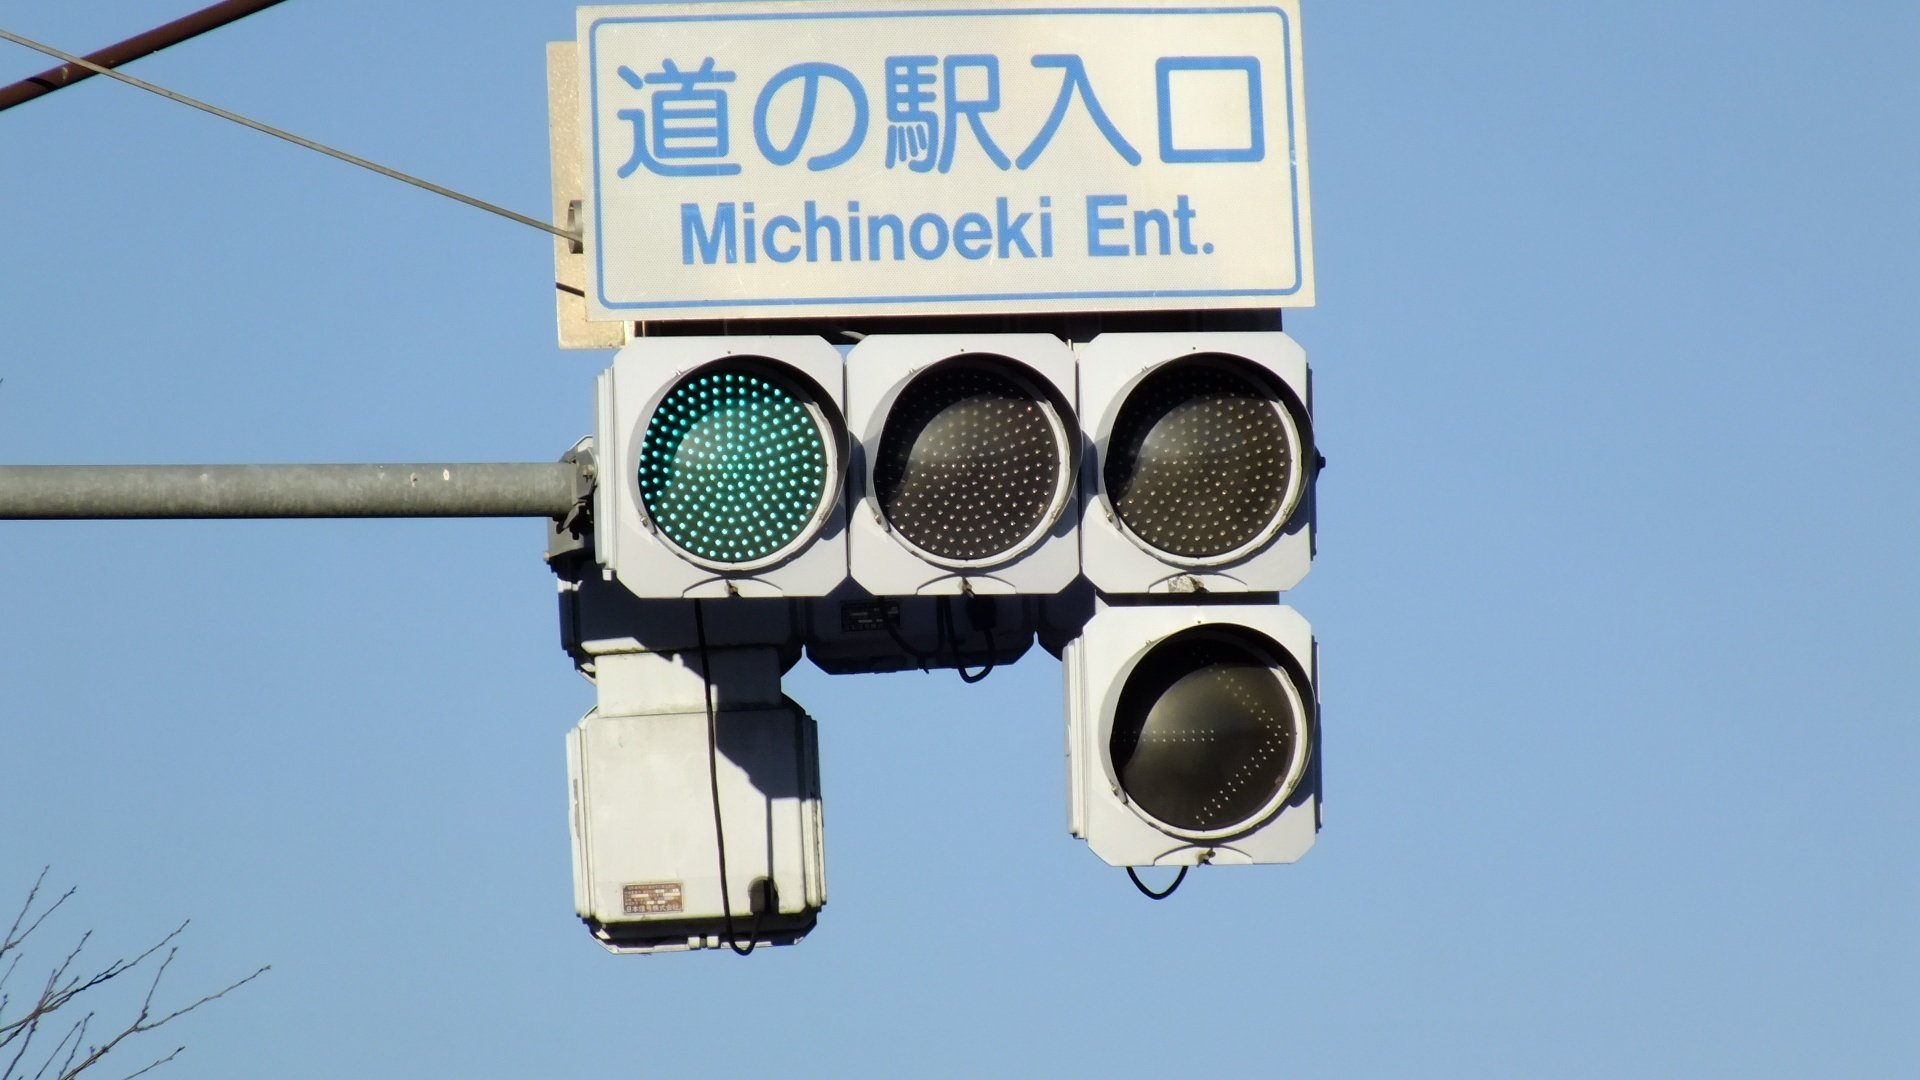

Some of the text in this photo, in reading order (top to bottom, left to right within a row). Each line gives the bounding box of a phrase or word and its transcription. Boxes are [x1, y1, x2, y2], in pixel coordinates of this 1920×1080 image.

[617, 54, 1265, 178] 道の駅入口
[681, 195, 1215, 265] Michinoeki Ent.
